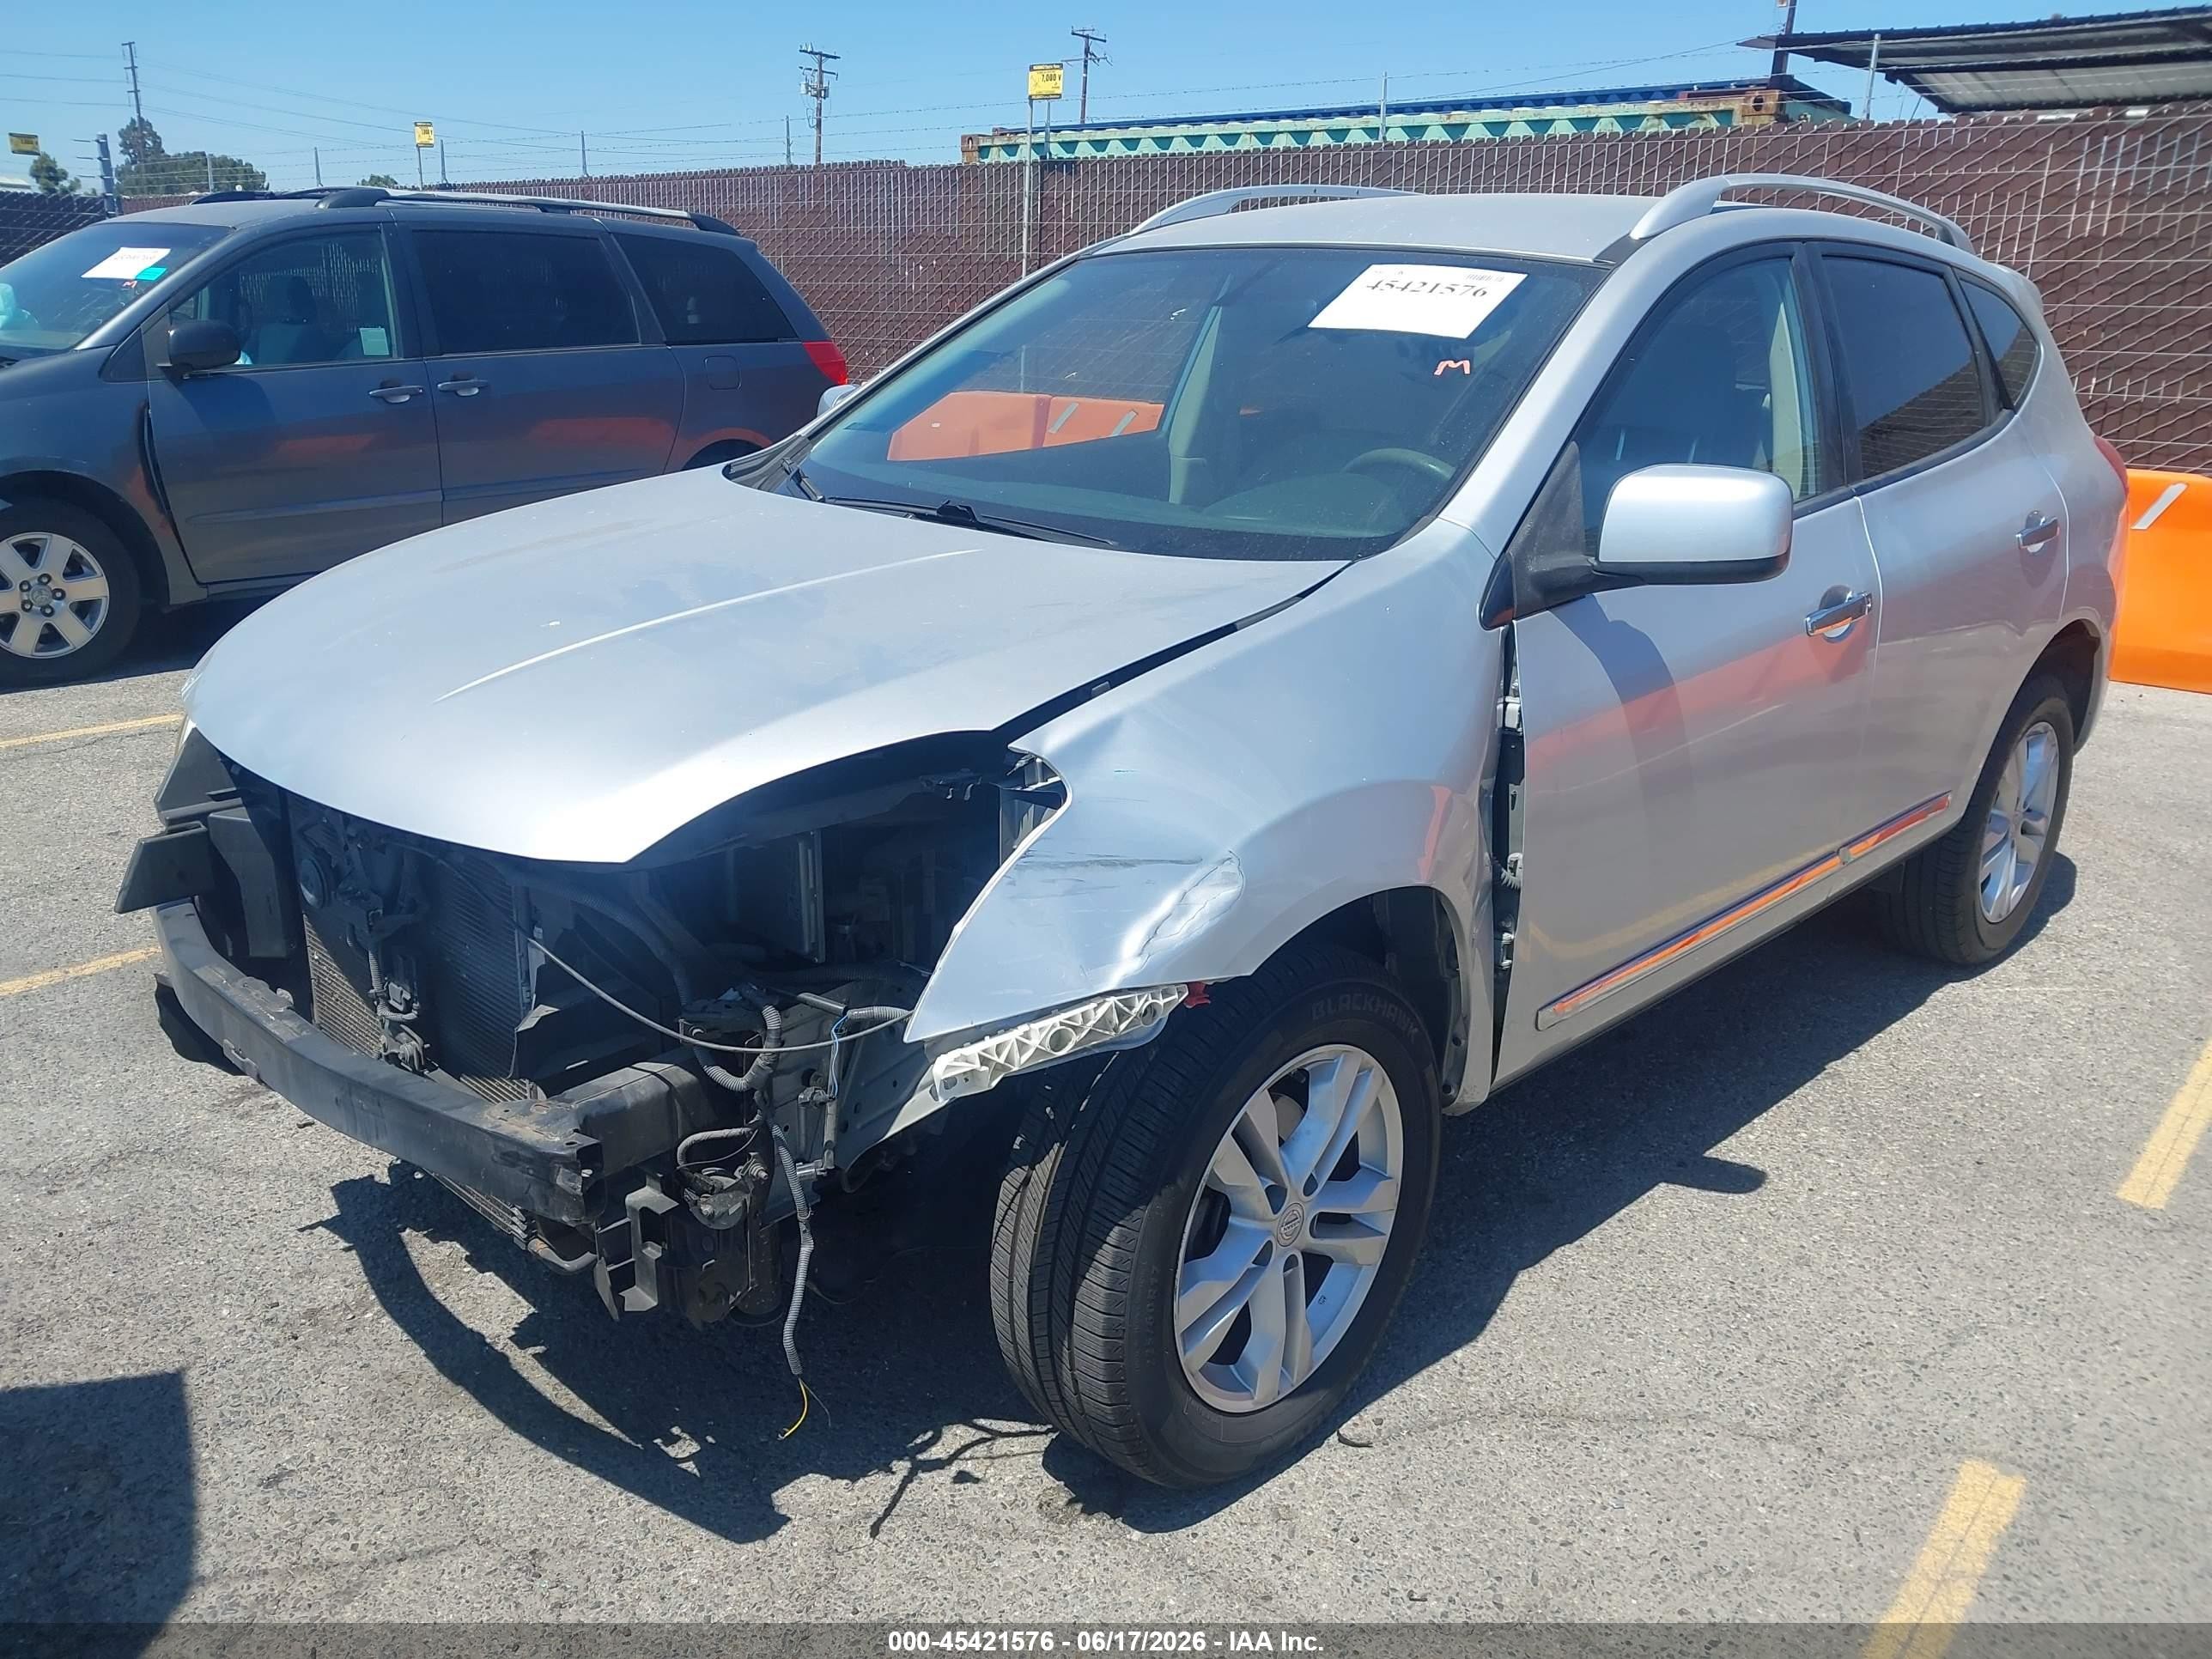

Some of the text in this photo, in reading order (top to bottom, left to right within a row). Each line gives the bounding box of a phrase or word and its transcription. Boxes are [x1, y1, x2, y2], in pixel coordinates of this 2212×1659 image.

[1042, 74, 1056, 82] 7,000
[1367, 279, 1488, 296] 45421576
[1434, 360, 1470, 375] M
[1311, 994, 1418, 1044] BLACKHAWK
